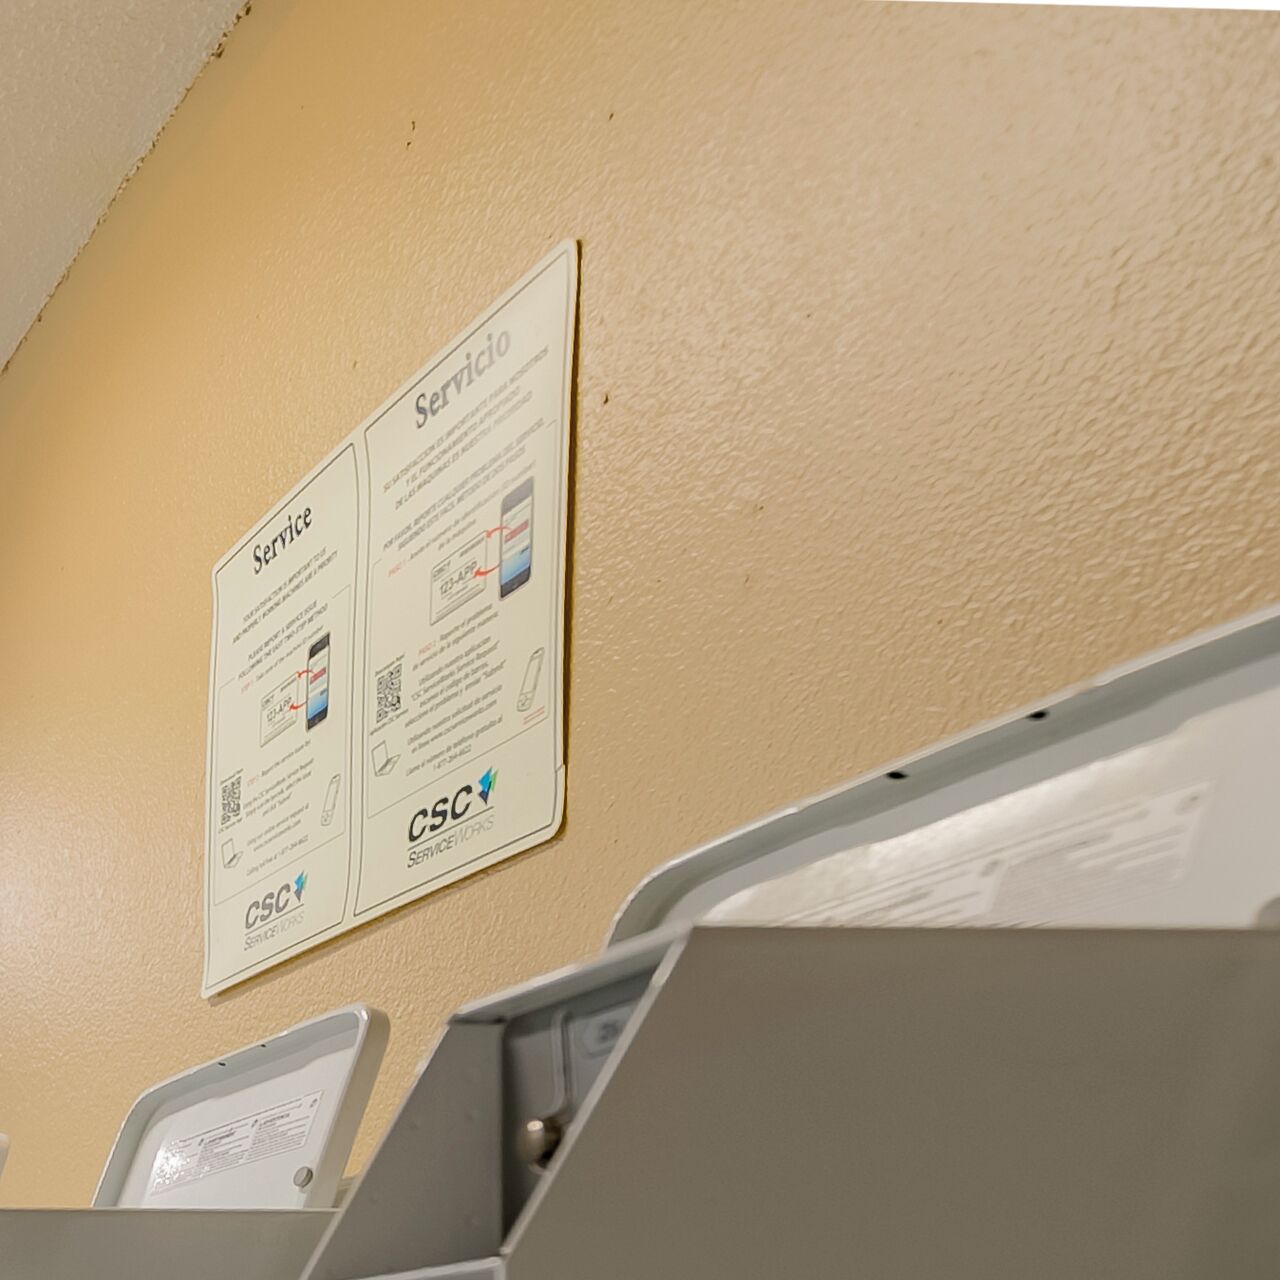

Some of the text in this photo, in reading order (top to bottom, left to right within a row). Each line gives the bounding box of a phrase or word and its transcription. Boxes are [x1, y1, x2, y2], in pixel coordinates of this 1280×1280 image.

[415, 330, 512, 430] Servicio
[253, 507, 313, 575] Service
[440, 558, 476, 598] 123-APP
[408, 786, 474, 844] CSC
[245, 883, 291, 930] CSC
